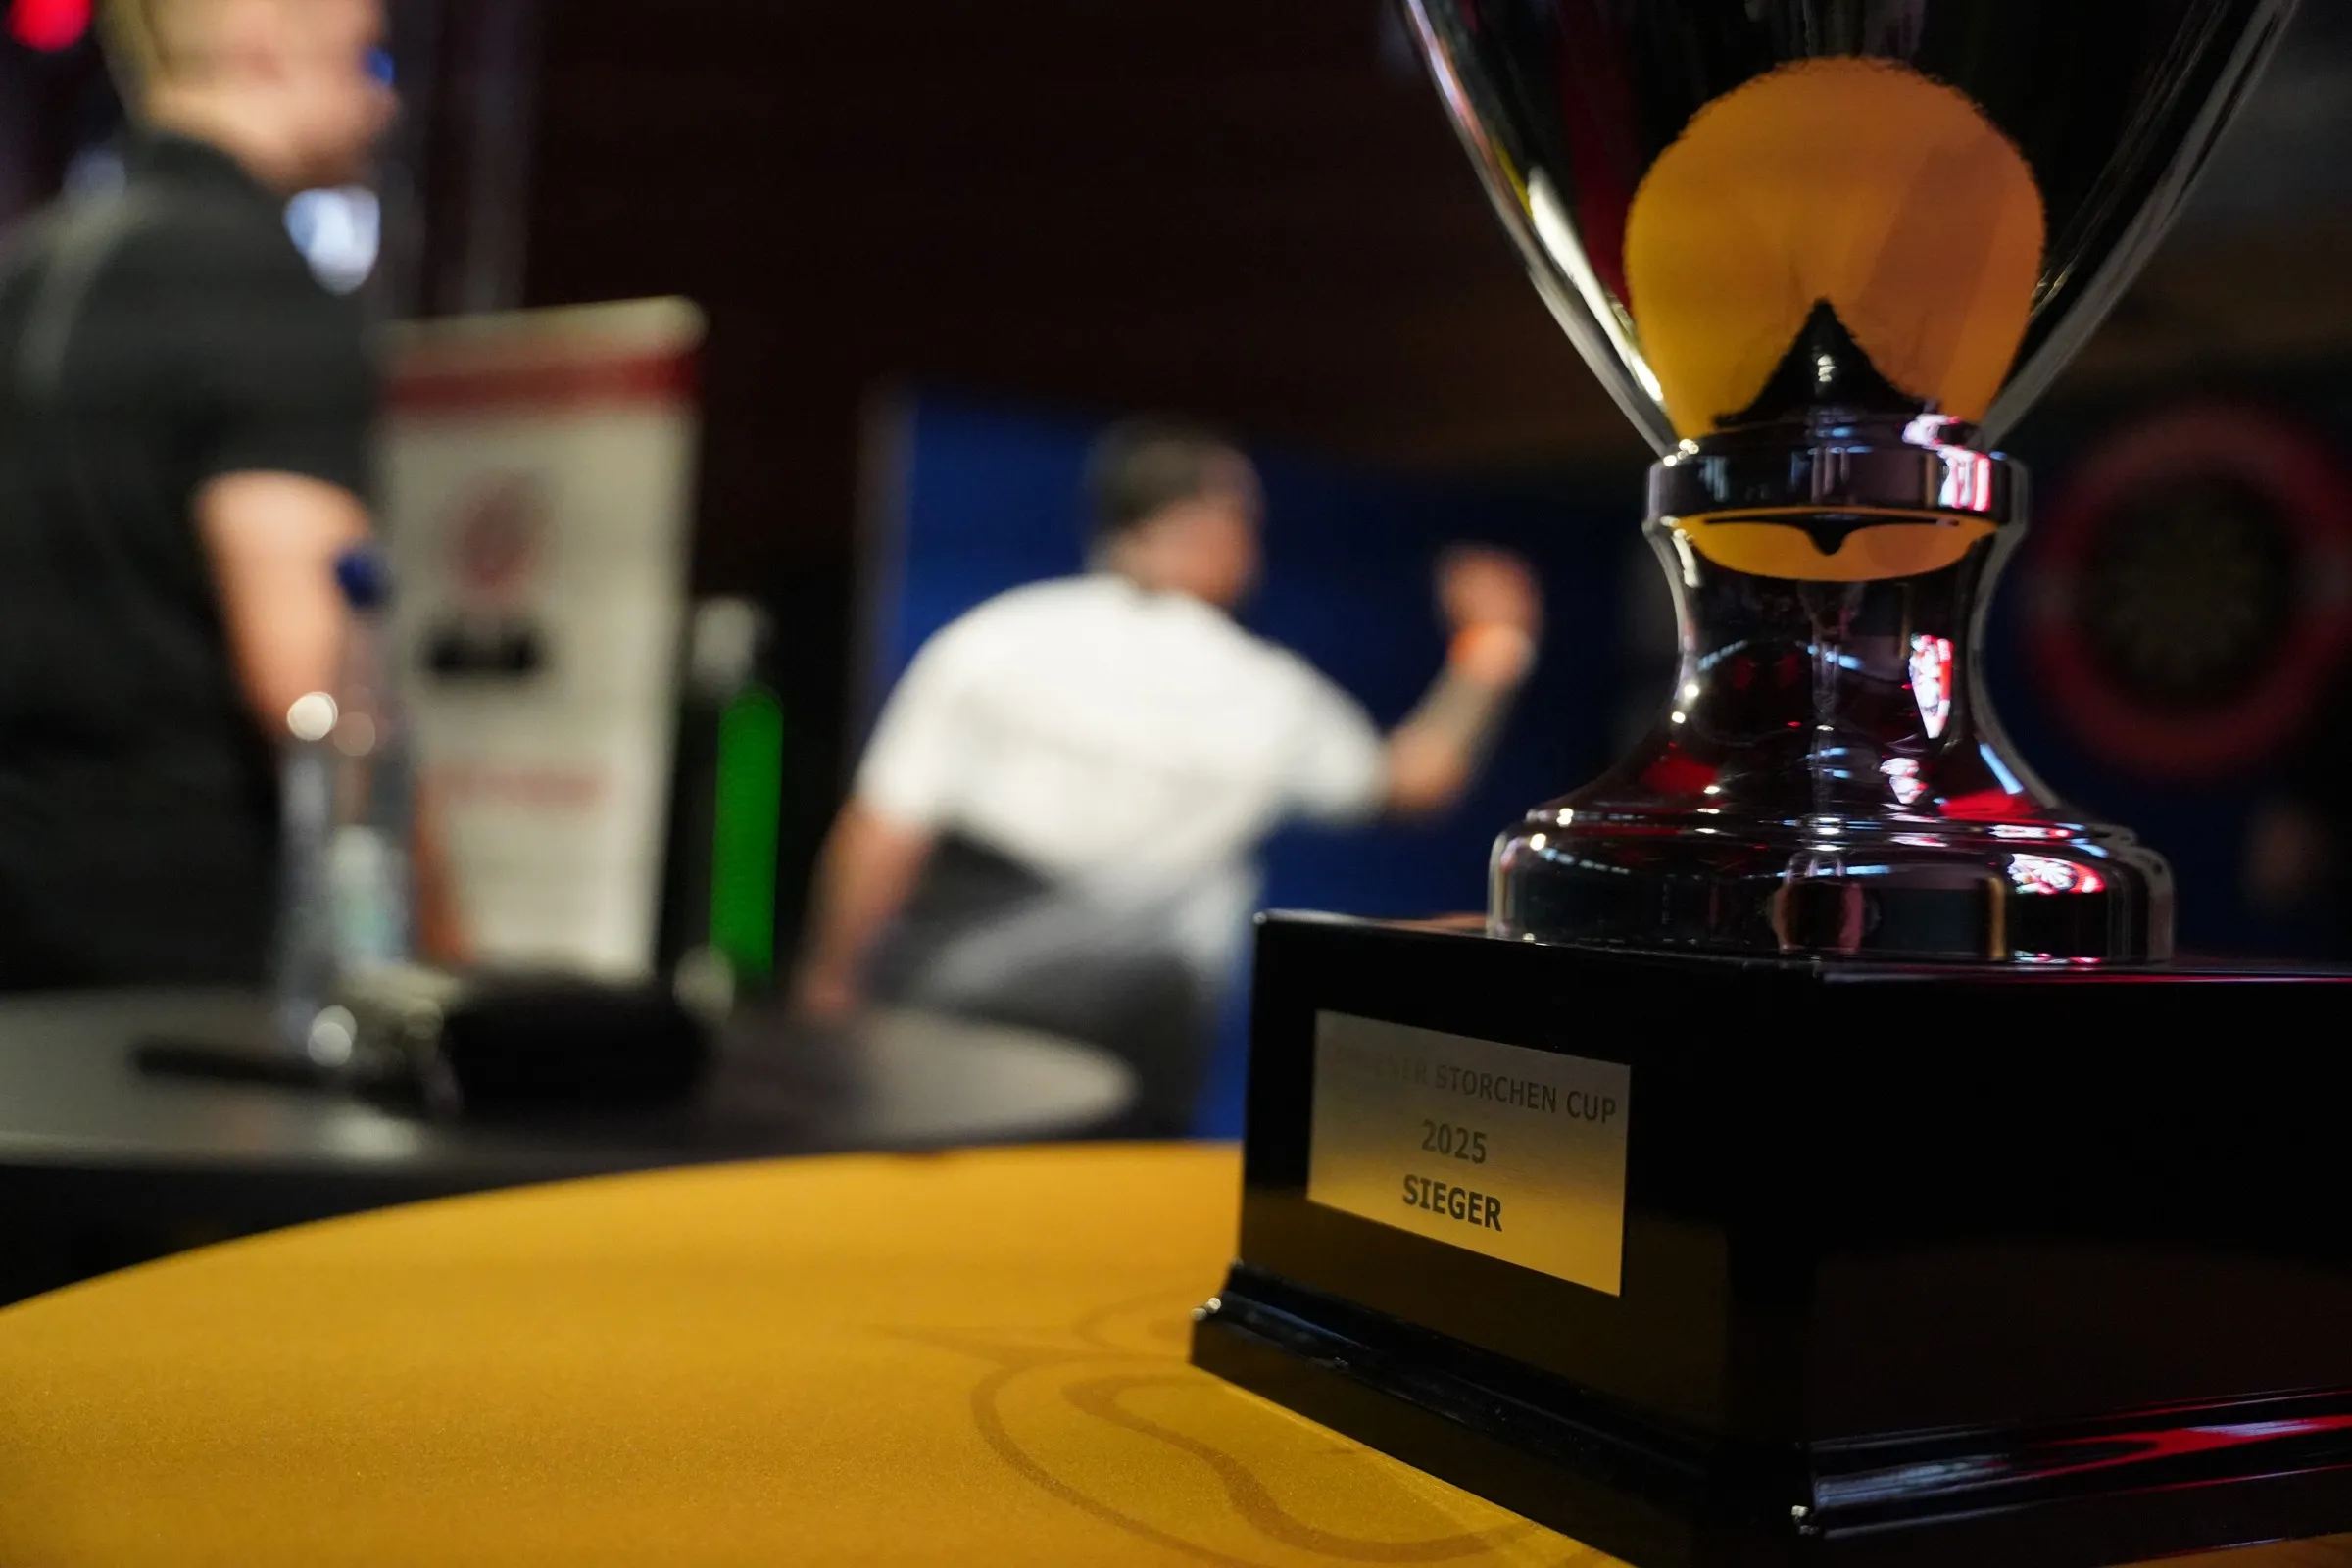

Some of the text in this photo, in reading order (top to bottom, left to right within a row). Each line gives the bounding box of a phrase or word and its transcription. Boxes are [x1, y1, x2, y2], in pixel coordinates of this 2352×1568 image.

[1434, 1063, 1557, 1113] STORCHEN
[1566, 1090, 1617, 1124] CUP
[1421, 1119, 1488, 1164] 2025
[1402, 1173, 1503, 1232] SIEGER
